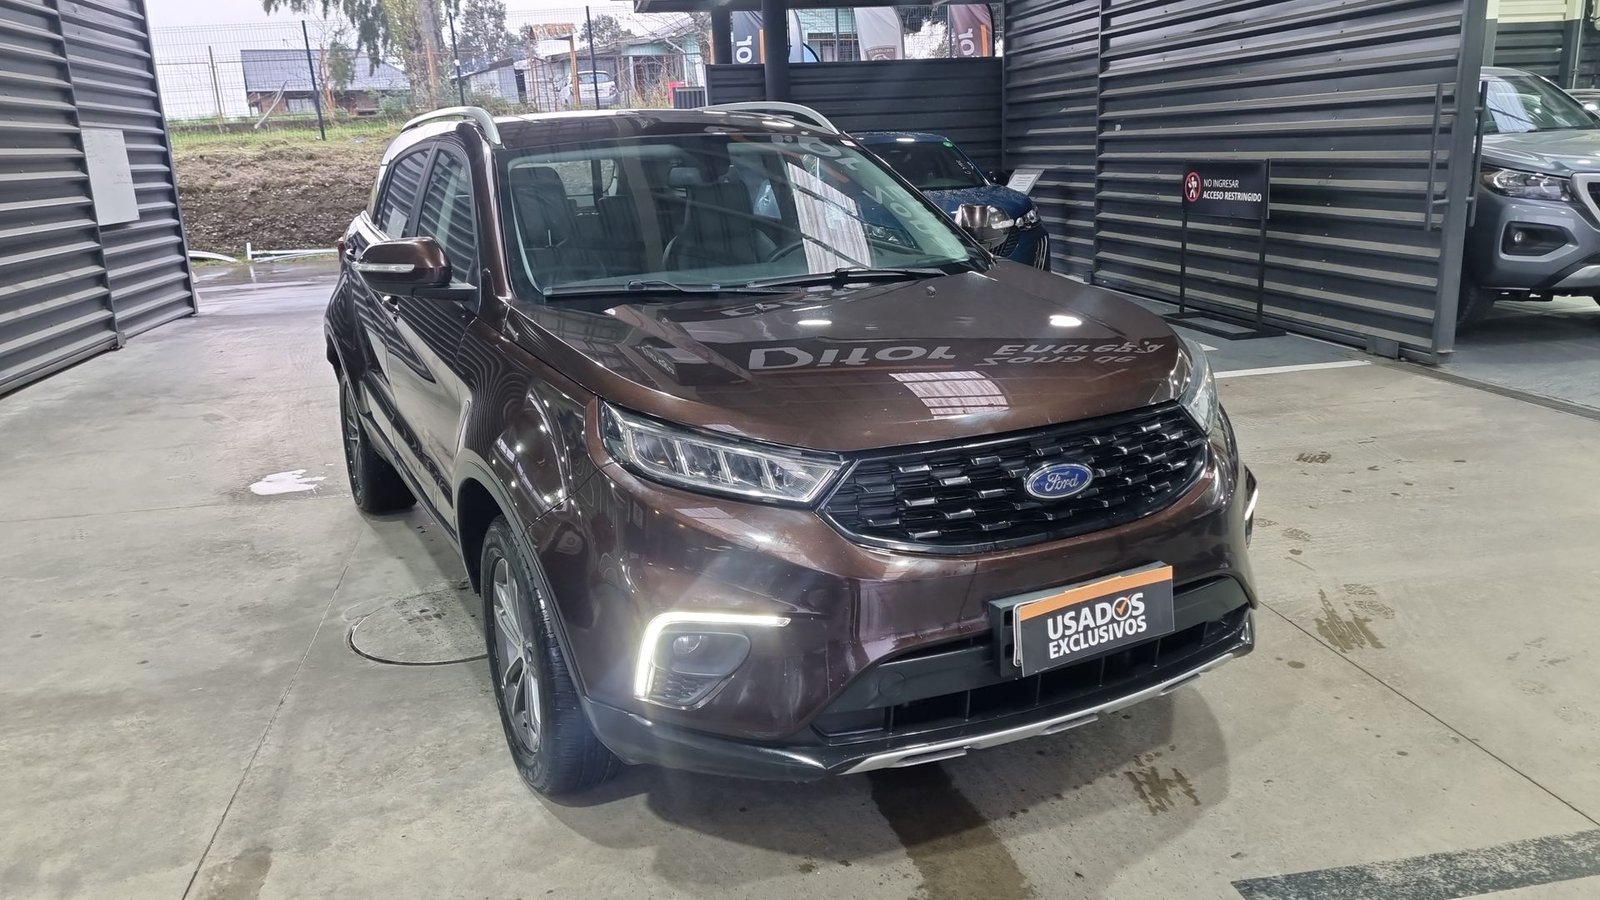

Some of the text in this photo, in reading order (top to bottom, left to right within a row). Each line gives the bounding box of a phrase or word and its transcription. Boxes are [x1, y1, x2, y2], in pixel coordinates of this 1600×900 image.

[1203, 179, 1239, 188] NO INGRESAR
[1202, 191, 1262, 202] ACCESO RESTRINGIDO
[1044, 470, 1079, 492] Ford
[1047, 592, 1145, 640] USADOS
[1048, 615, 1147, 659] EXCLUSIVOS
